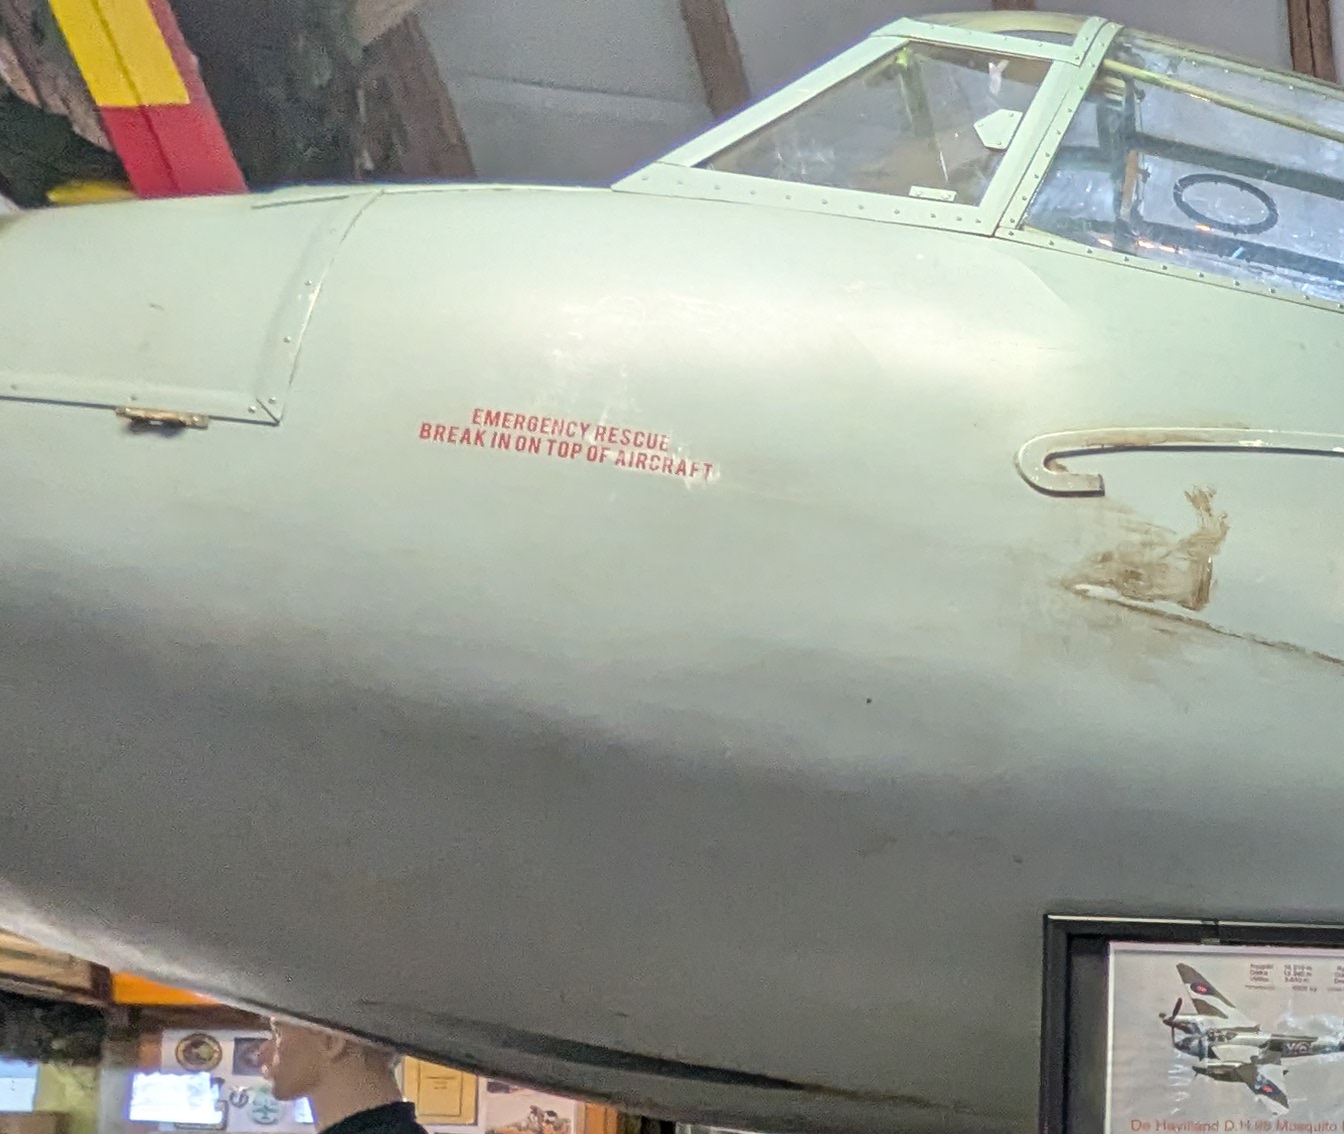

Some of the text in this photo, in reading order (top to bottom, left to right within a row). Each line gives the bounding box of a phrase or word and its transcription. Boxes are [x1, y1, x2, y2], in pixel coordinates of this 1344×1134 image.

[419, 422, 714, 480] BREAK IN ON TOP OF AIRCRAFT
[472, 408, 671, 452] EMERGENCY RESCUE
[1130, 1119, 1152, 1133] De
[1156, 1119, 1219, 1133] Havilland
